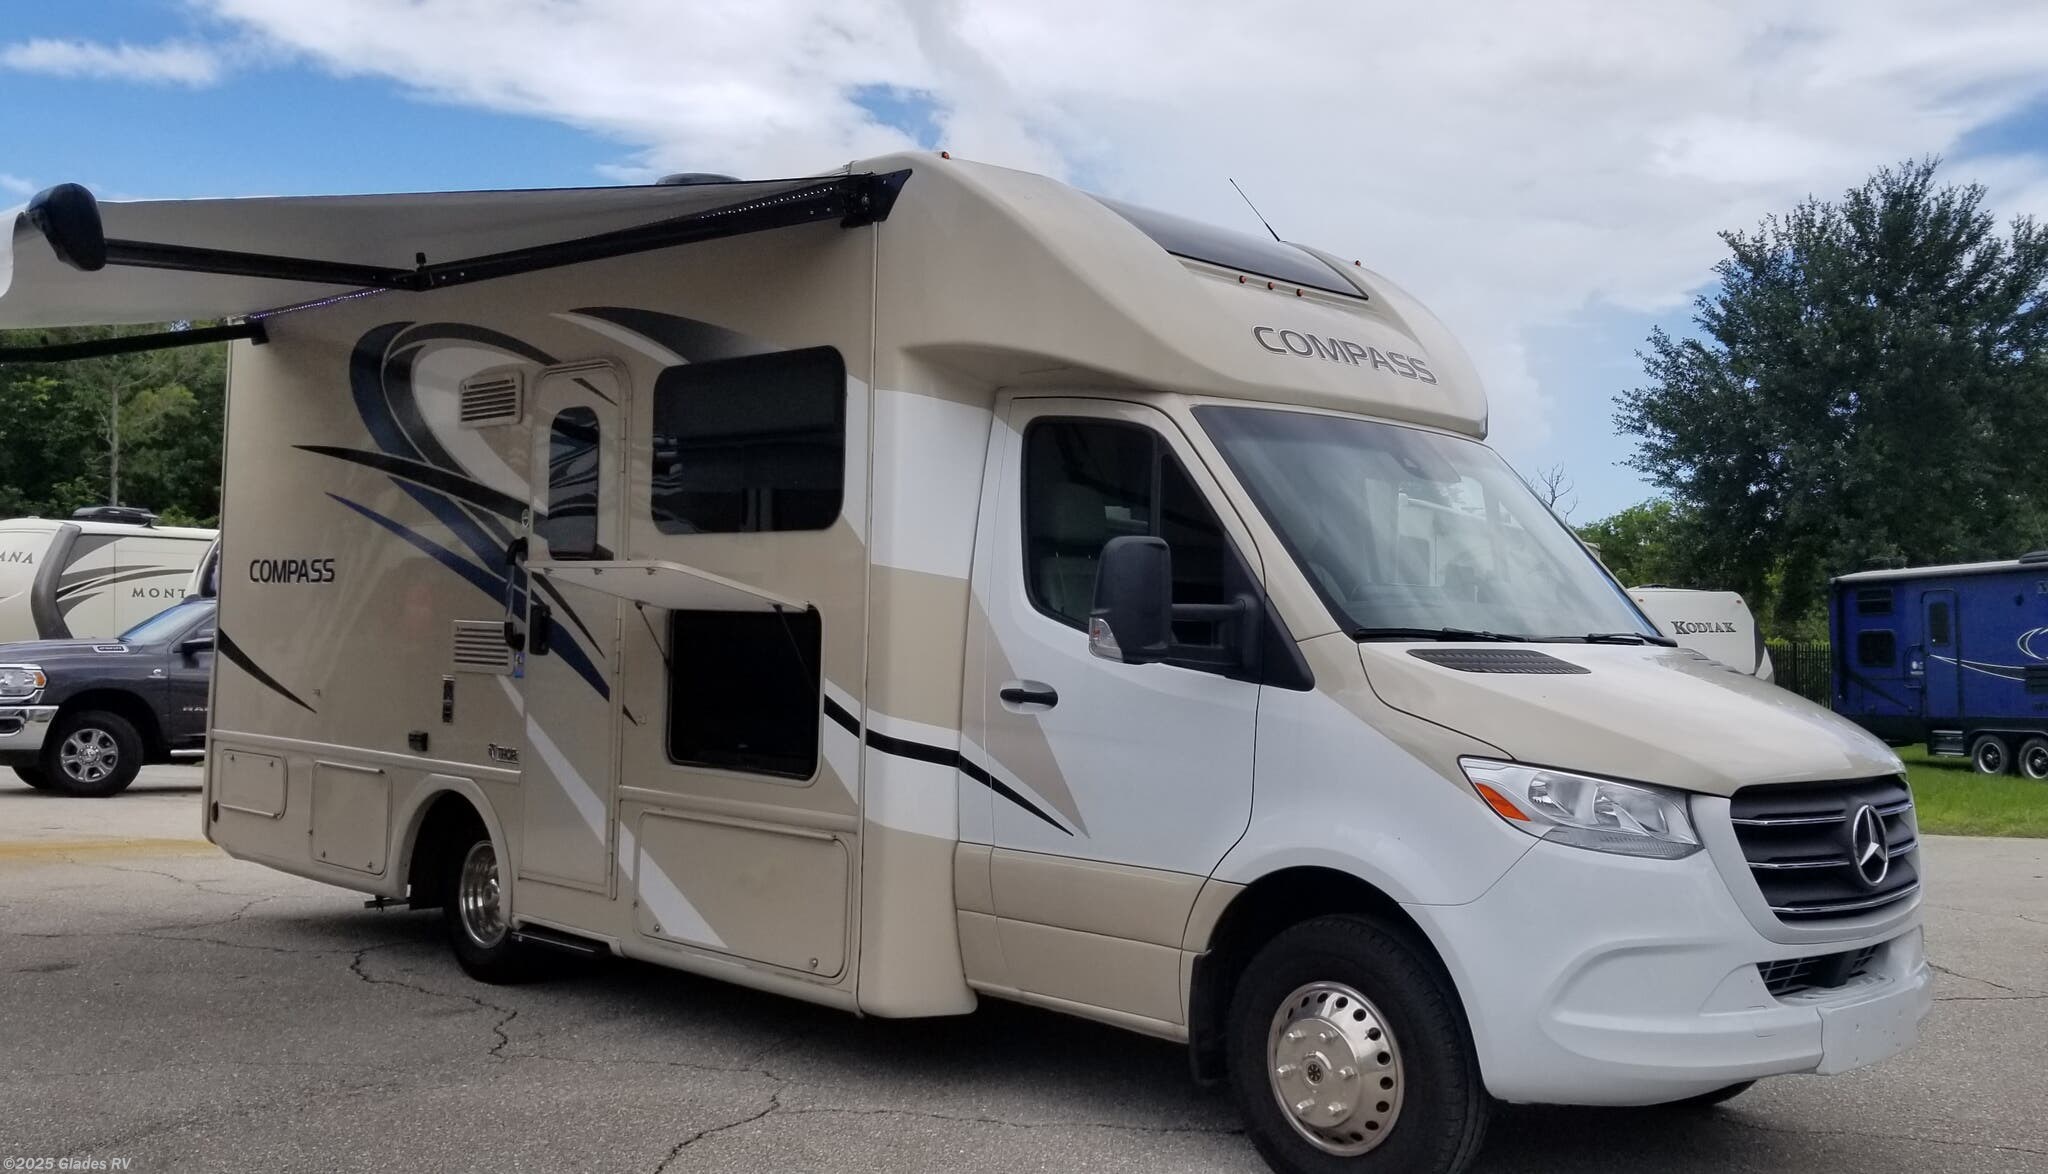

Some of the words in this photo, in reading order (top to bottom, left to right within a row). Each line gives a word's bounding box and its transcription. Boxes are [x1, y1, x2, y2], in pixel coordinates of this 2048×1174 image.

[1252, 325, 1439, 386] COMPASS
[249, 558, 335, 583] COMPASS
[1670, 620, 1737, 635] KODIAK
[496, 747, 520, 762] THOR
